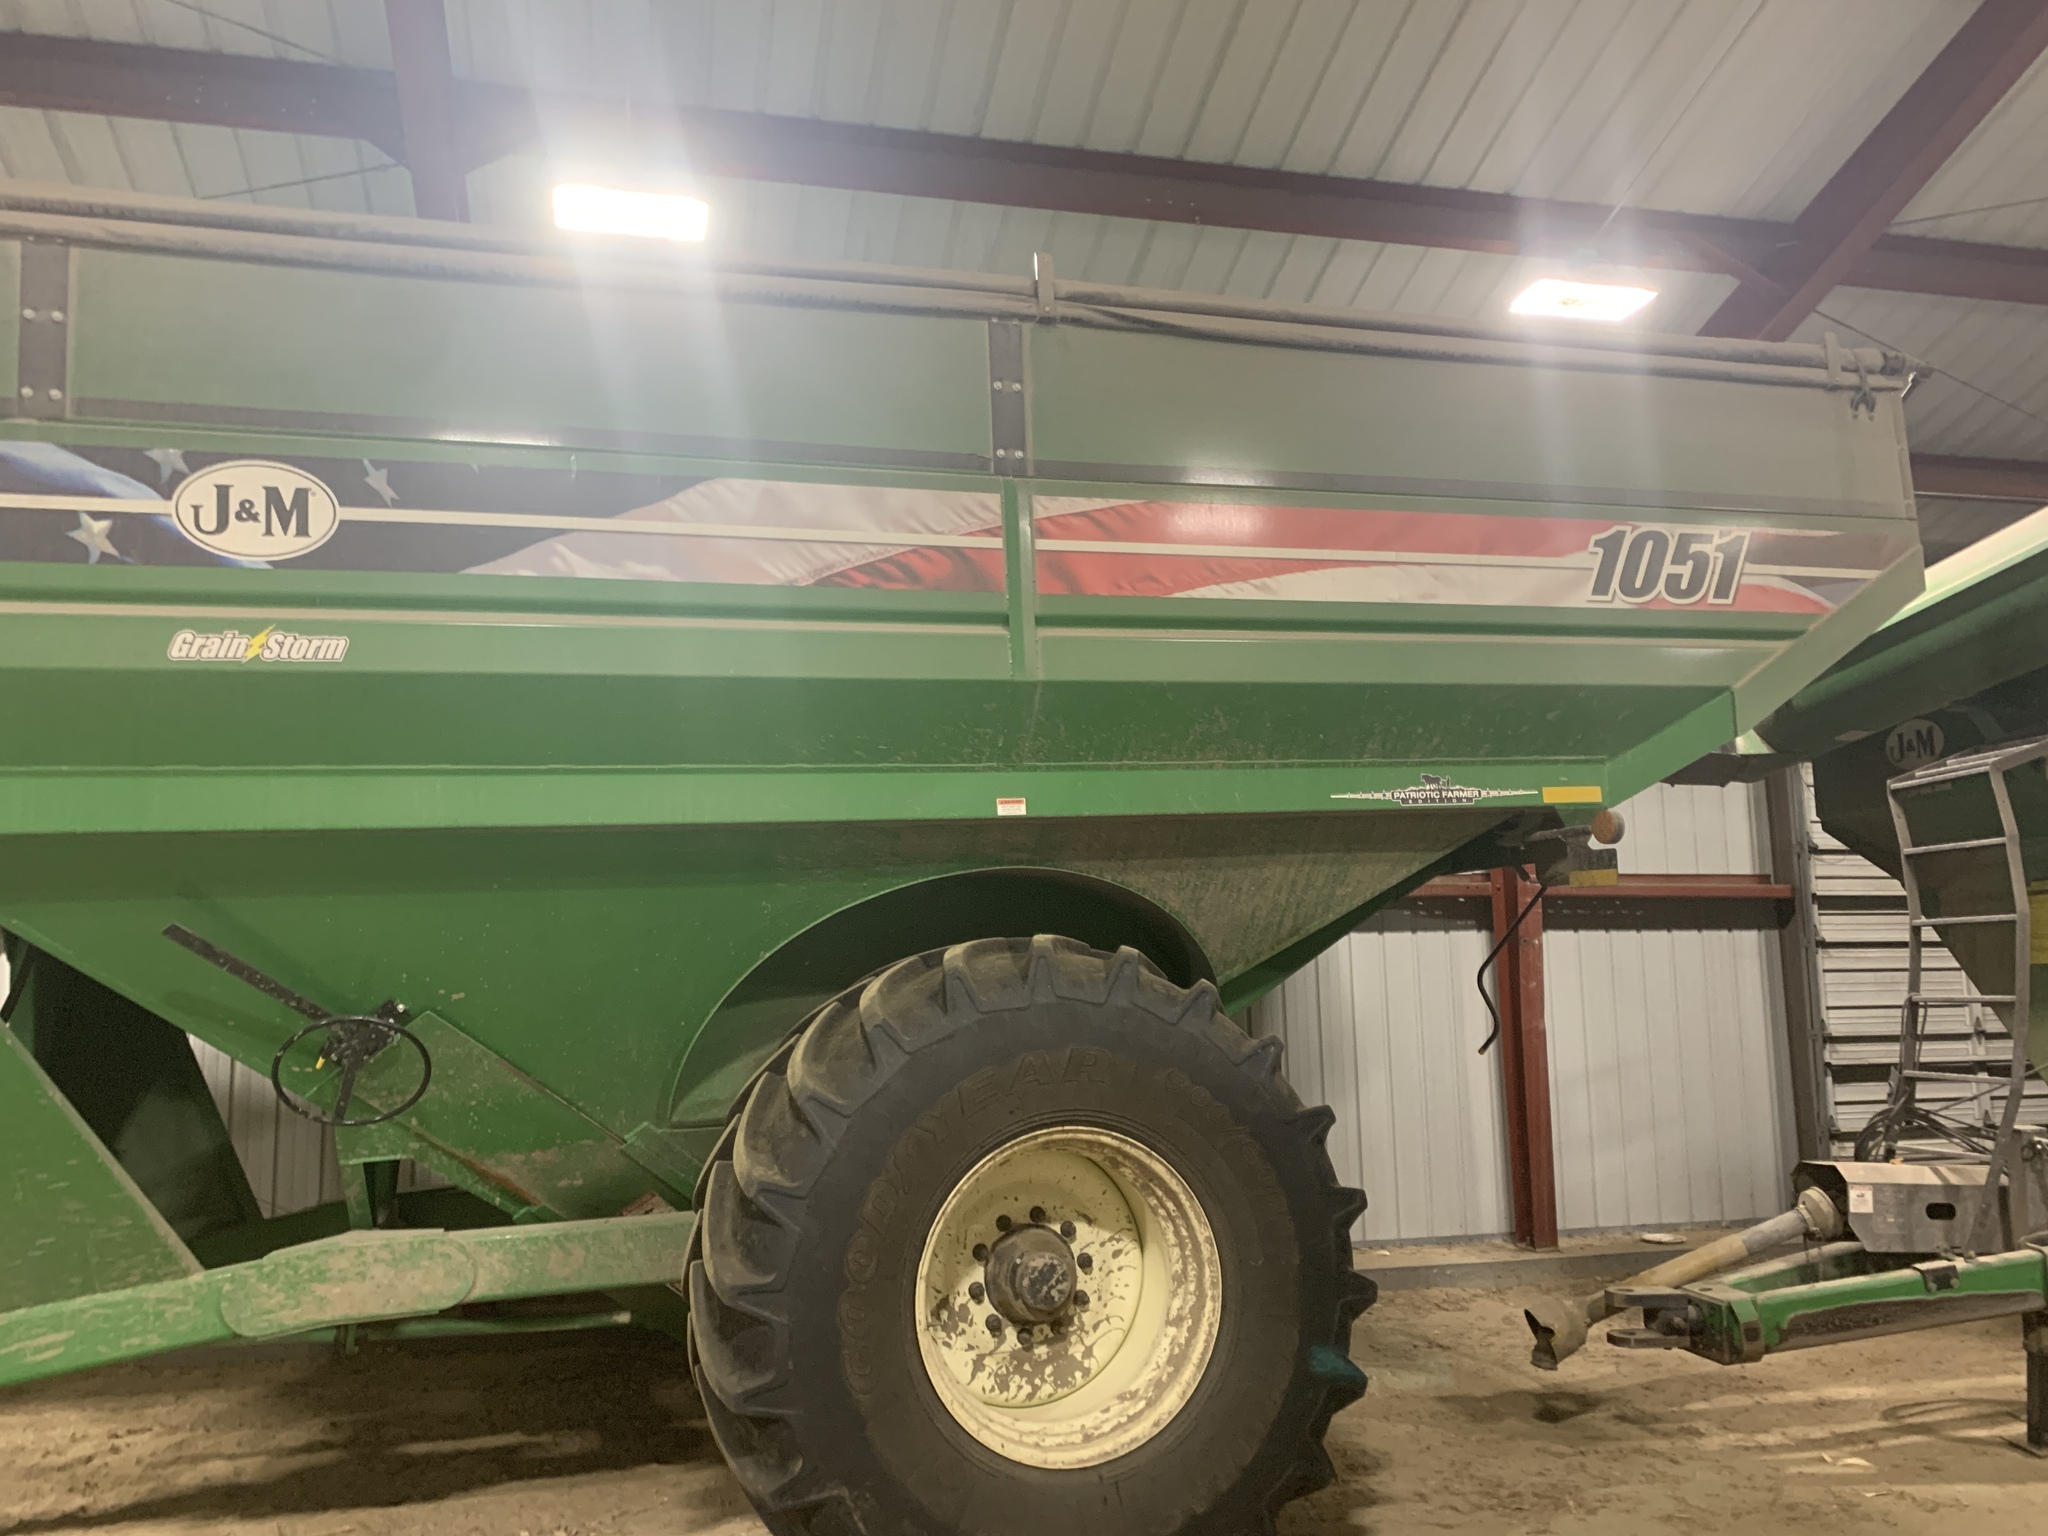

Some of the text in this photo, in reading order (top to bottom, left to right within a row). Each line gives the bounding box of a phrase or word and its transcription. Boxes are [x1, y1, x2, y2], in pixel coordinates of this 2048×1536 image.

[190, 484, 312, 538] J&M
[1586, 525, 1751, 605] 1051
[167, 629, 349, 662] Grain Storm
[1891, 725, 1935, 762] J&M
[1394, 790, 1479, 800] PATRIOTIC FARMER
